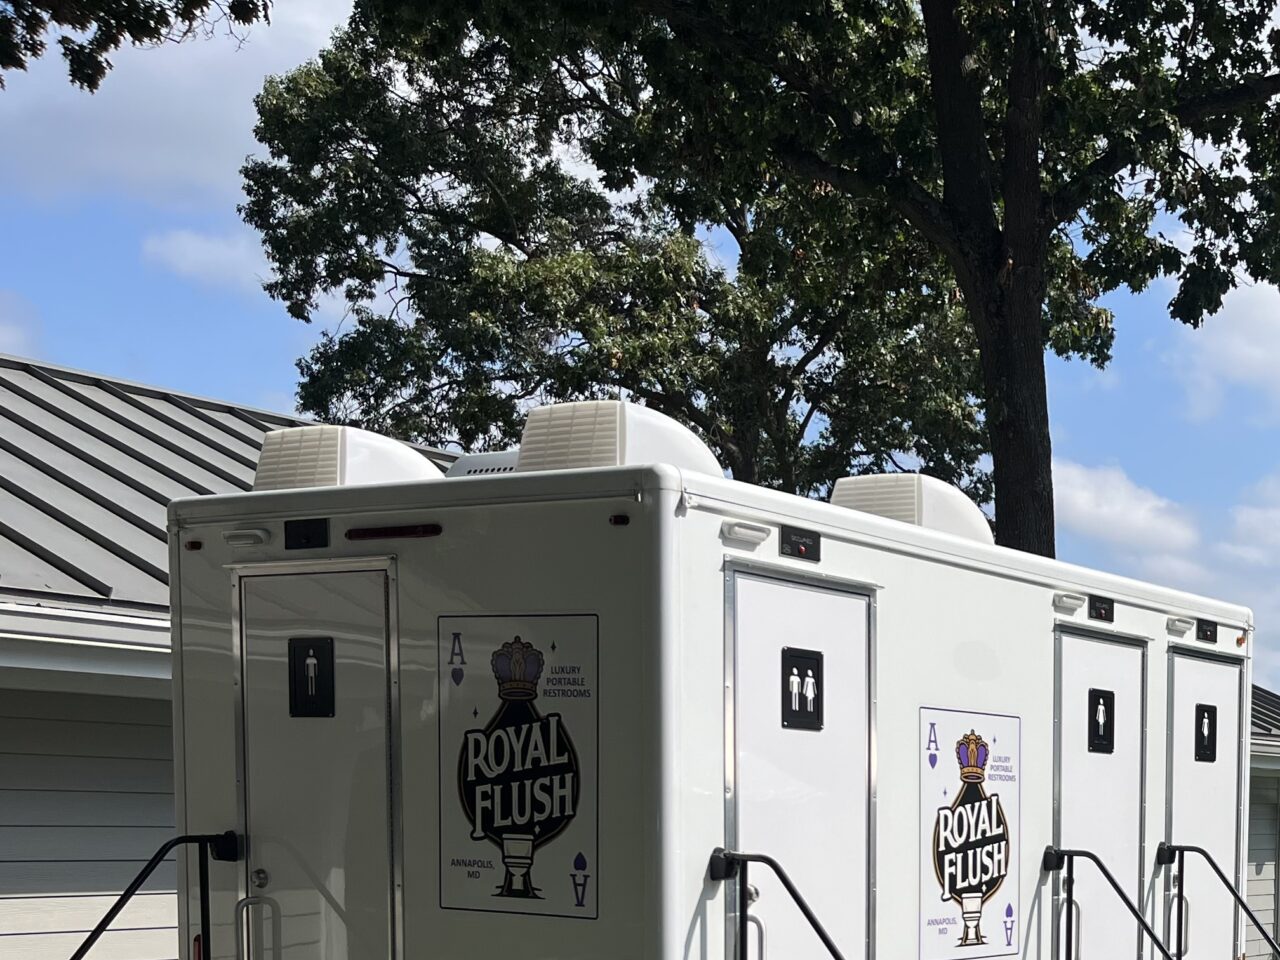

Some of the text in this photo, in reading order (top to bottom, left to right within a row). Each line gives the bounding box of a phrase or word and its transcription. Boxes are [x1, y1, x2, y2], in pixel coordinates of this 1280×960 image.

[550, 666, 581, 675] LUXURY
[546, 677, 586, 687] PORTABLE
[542, 688, 592, 698] RESTROOMS
[466, 714, 569, 781] ROYAL
[992, 755, 1011, 764] LUXURY
[990, 764, 1013, 773] PORTABLE
[988, 773, 1017, 782] RESTROOMS
[472, 772, 575, 838] FLUSH
[938, 794, 1004, 851] ROYAL
[467, 870, 480, 880] MD
[943, 840, 1007, 900] FLUSH
[938, 926, 948, 935] MD
